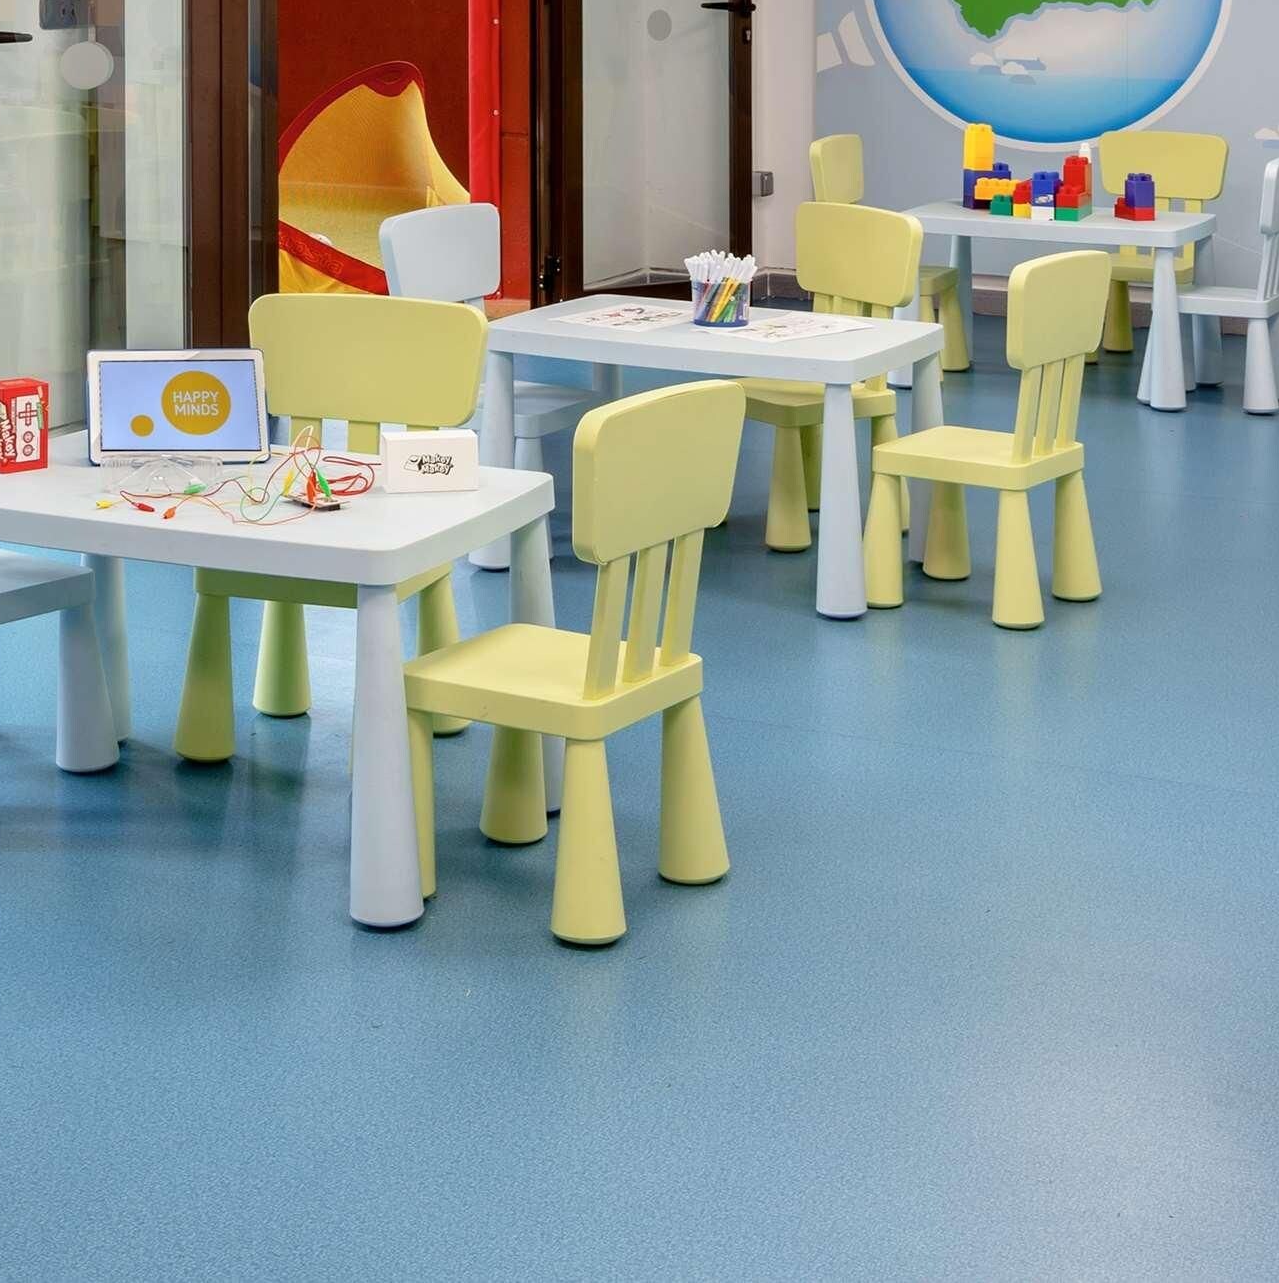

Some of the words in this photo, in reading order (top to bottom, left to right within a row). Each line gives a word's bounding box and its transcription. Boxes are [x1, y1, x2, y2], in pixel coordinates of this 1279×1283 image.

[172, 390, 219, 403] HAPPY
[175, 403, 219, 416] MINDS
[0, 419, 17, 458] Makey
[421, 453, 453, 465] Makey
[421, 464, 454, 475] Makey
